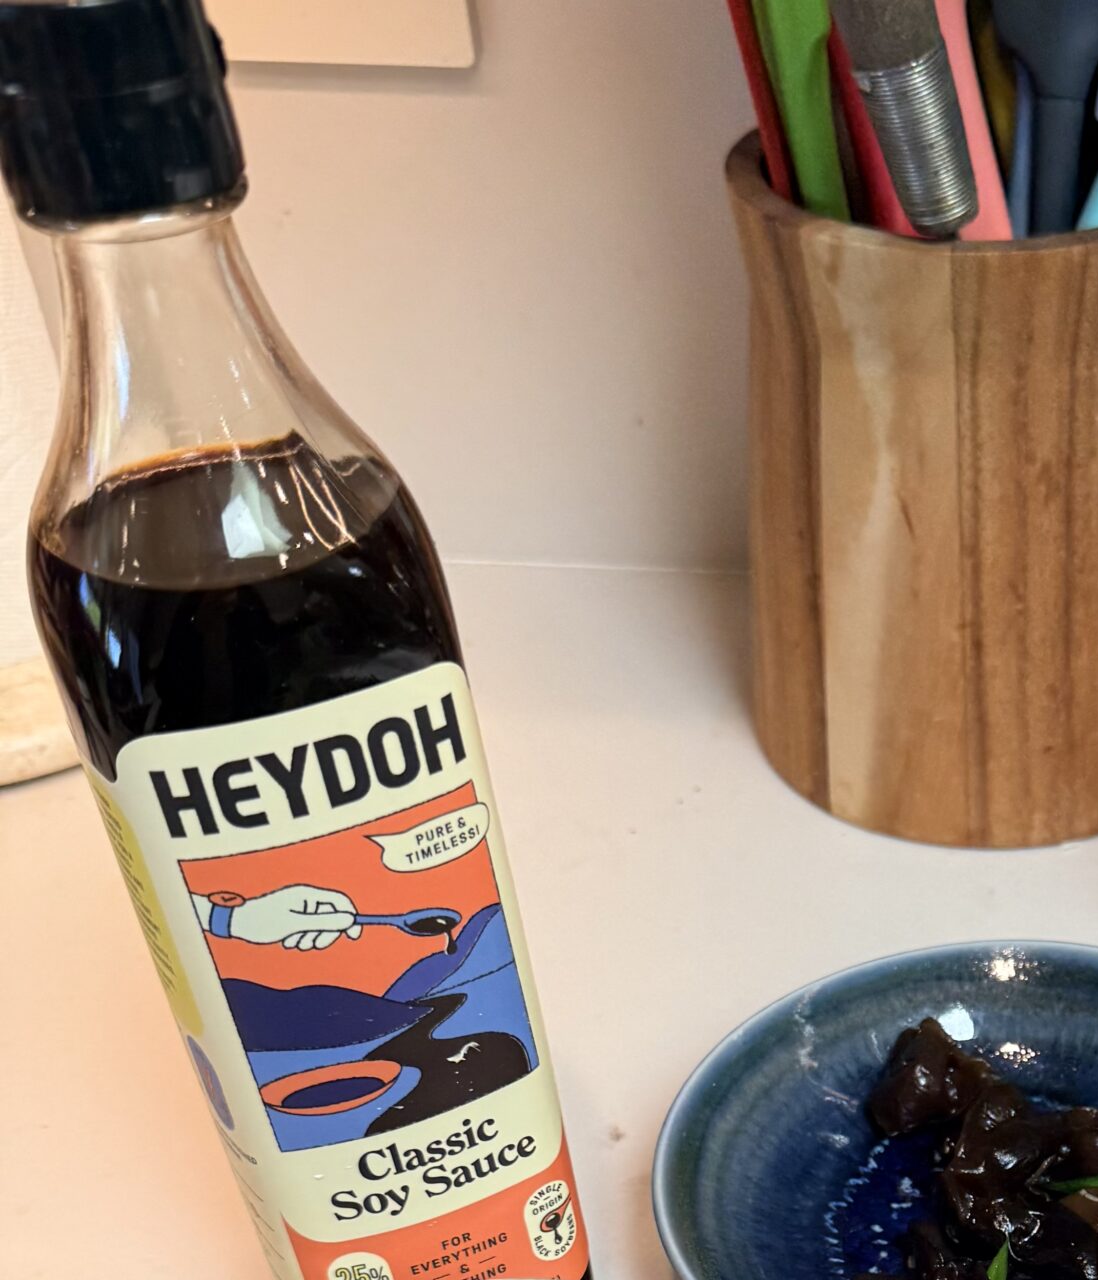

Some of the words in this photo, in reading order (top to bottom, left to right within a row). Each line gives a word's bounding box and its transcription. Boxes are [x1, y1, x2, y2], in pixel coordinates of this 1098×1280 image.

[149, 693, 467, 838] HEYDOH
[415, 822, 454, 846] PURE
[457, 816, 467, 829] &
[358, 1118, 499, 1181] Classic
[331, 1185, 410, 1221] Soy
[422, 1136, 537, 1198] Sauce
[529, 1183, 563, 1206] SINGLE
[532, 1193, 563, 1216] ORIGIN
[410, 1232, 508, 1275] EVERYTHING
[441, 1232, 472, 1250] FOR
[534, 1235, 551, 1257] BLACK
[460, 1263, 470, 1274] &
